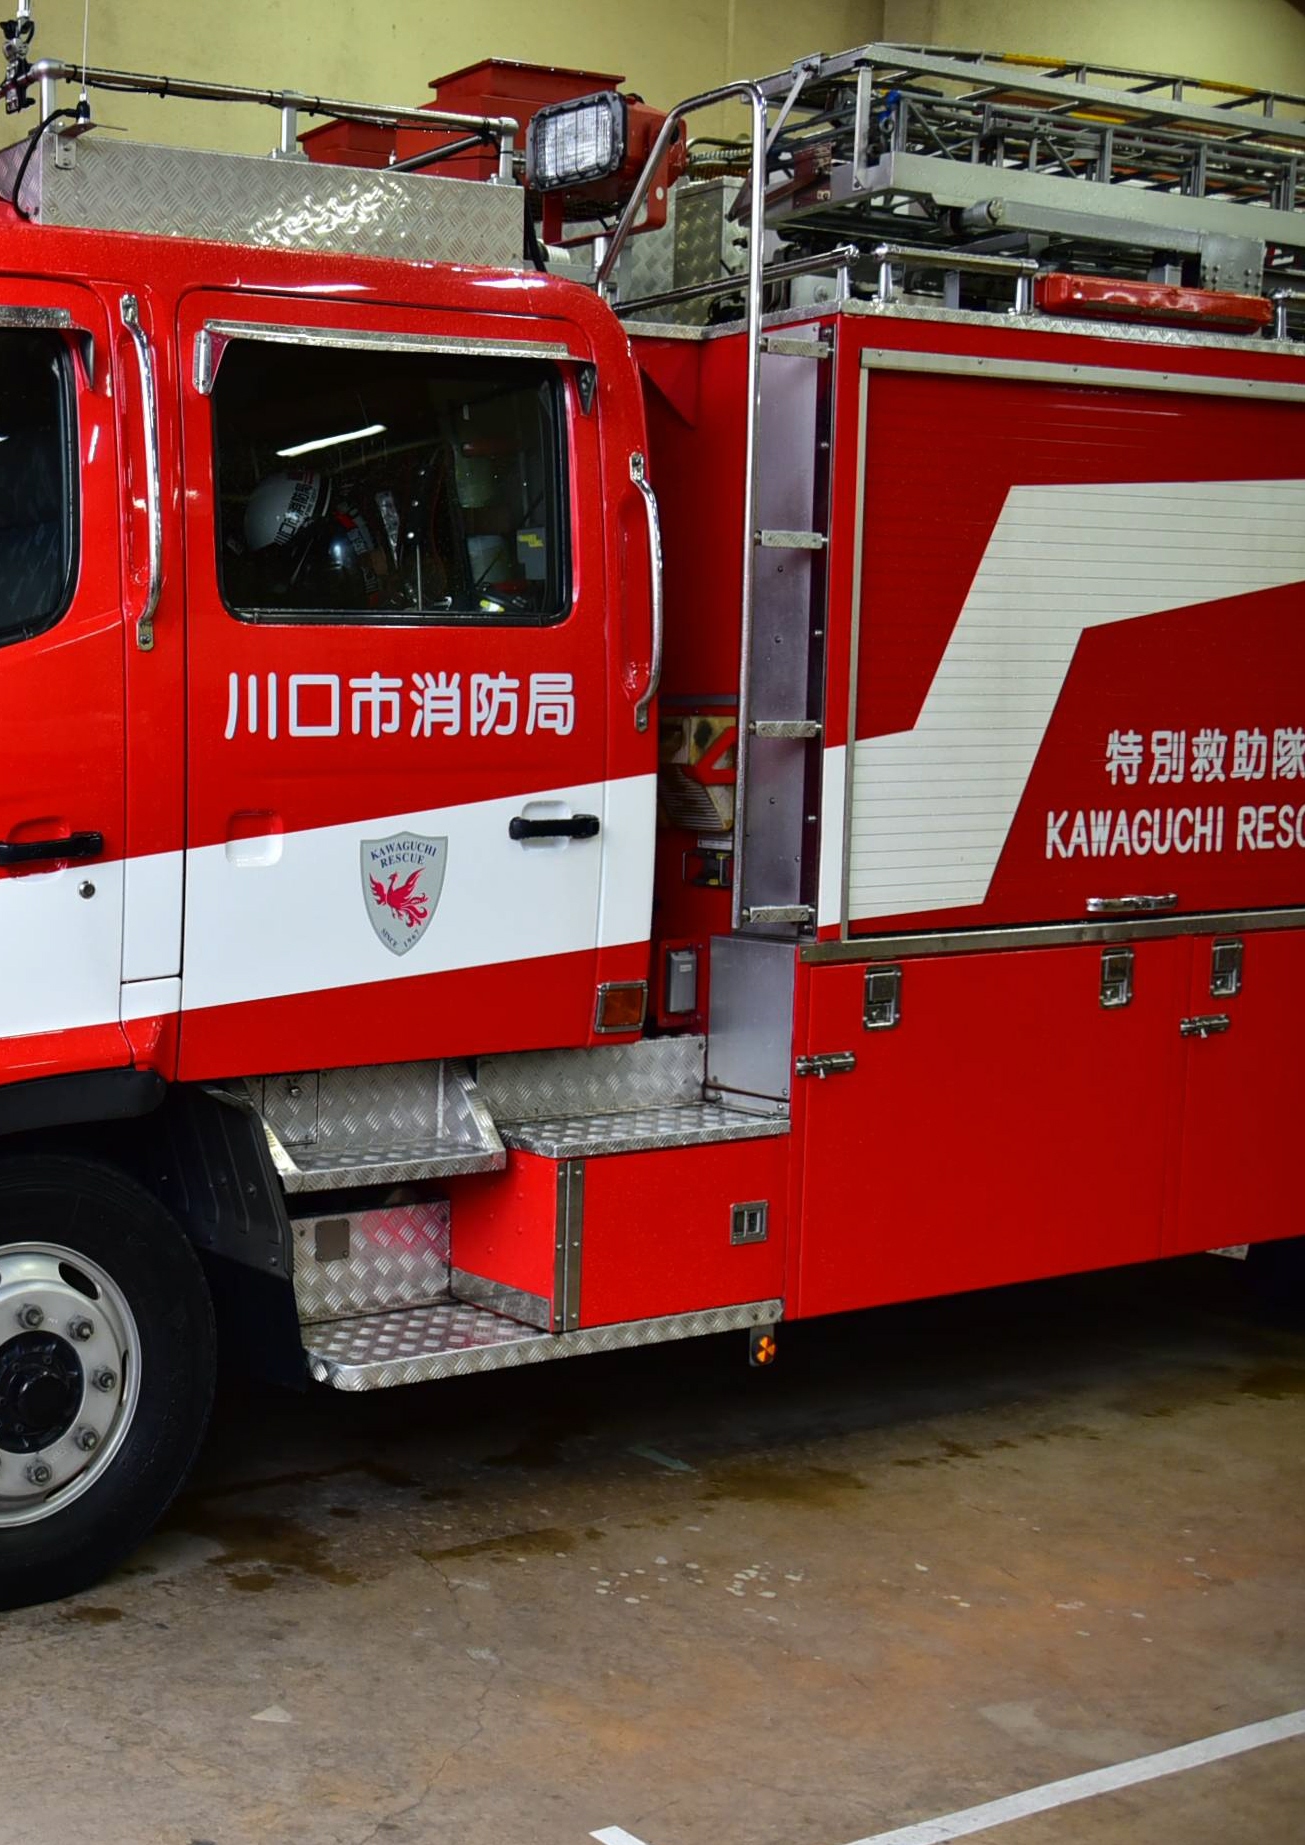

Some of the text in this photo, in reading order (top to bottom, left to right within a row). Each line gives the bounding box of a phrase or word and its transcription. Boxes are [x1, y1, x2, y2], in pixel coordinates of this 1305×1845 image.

[224, 671, 575, 740] 川口市消防局
[1105, 727, 1305, 785] 特別救助隊
[370, 841, 437, 860] KAWAGUCHI
[1046, 806, 1224, 859] KAWAGUCHI
[380, 853, 425, 868] RESCUE
[381, 928, 398, 947] SINCE
